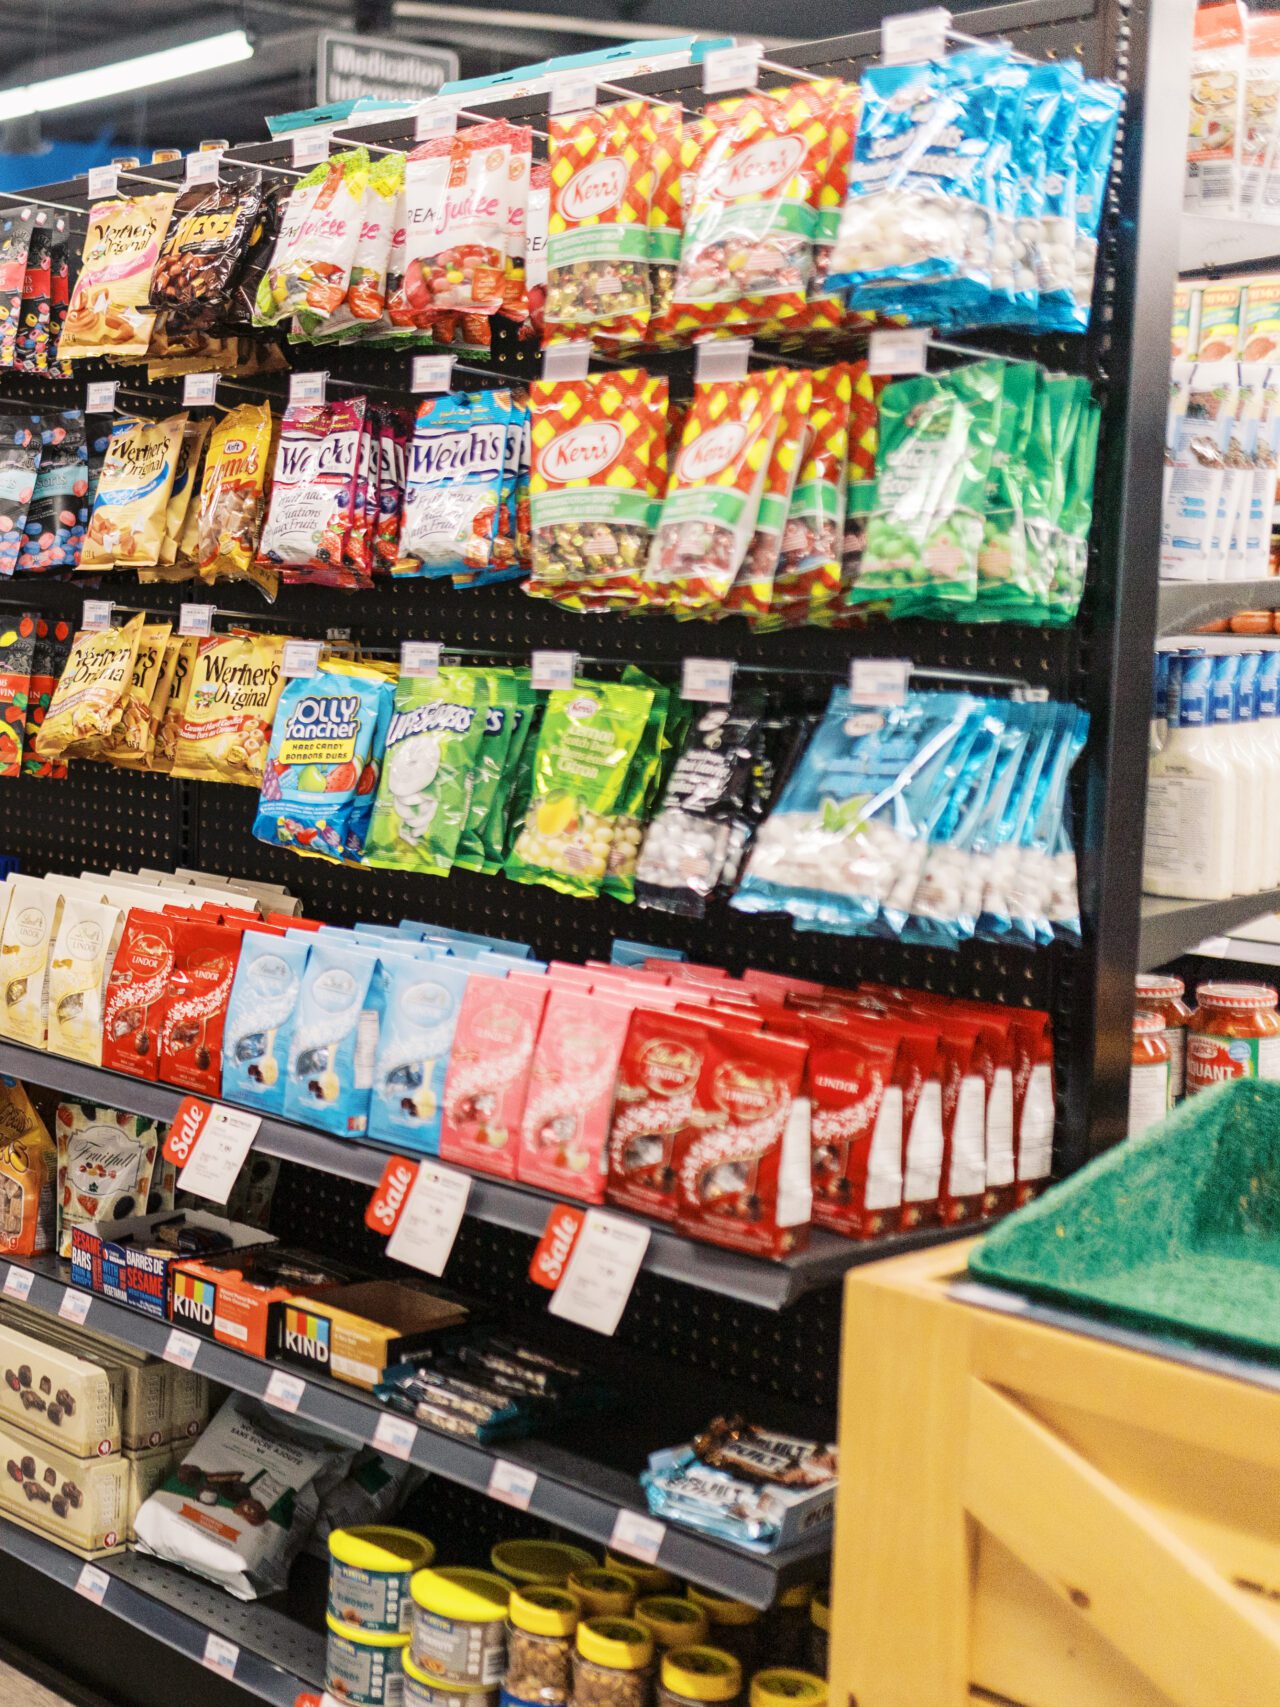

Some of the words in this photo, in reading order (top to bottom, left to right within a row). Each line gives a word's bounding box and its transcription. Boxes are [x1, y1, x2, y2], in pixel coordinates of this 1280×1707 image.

[573, 171, 619, 205] Kerr's
[556, 435, 609, 465] Kerr's
[203, 654, 281, 687] Werther's
[214, 681, 273, 711] Original
[292, 696, 358, 725] JOLLY
[286, 718, 359, 739] rancher
[131, 956, 159, 969] LINDOR
[194, 969, 220, 982] LINDOR
[169, 1105, 204, 1161] Sale
[373, 1165, 413, 1227] Sale
[72, 1228, 102, 1257] SESAME
[537, 1215, 579, 1281] Sale
[71, 1246, 92, 1271] BARS
[102, 1260, 119, 1275] WITH
[125, 1249, 153, 1273] BARRES
[153, 1258, 164, 1276] DE
[173, 1295, 213, 1327] KIND
[285, 1331, 329, 1364] KIND
